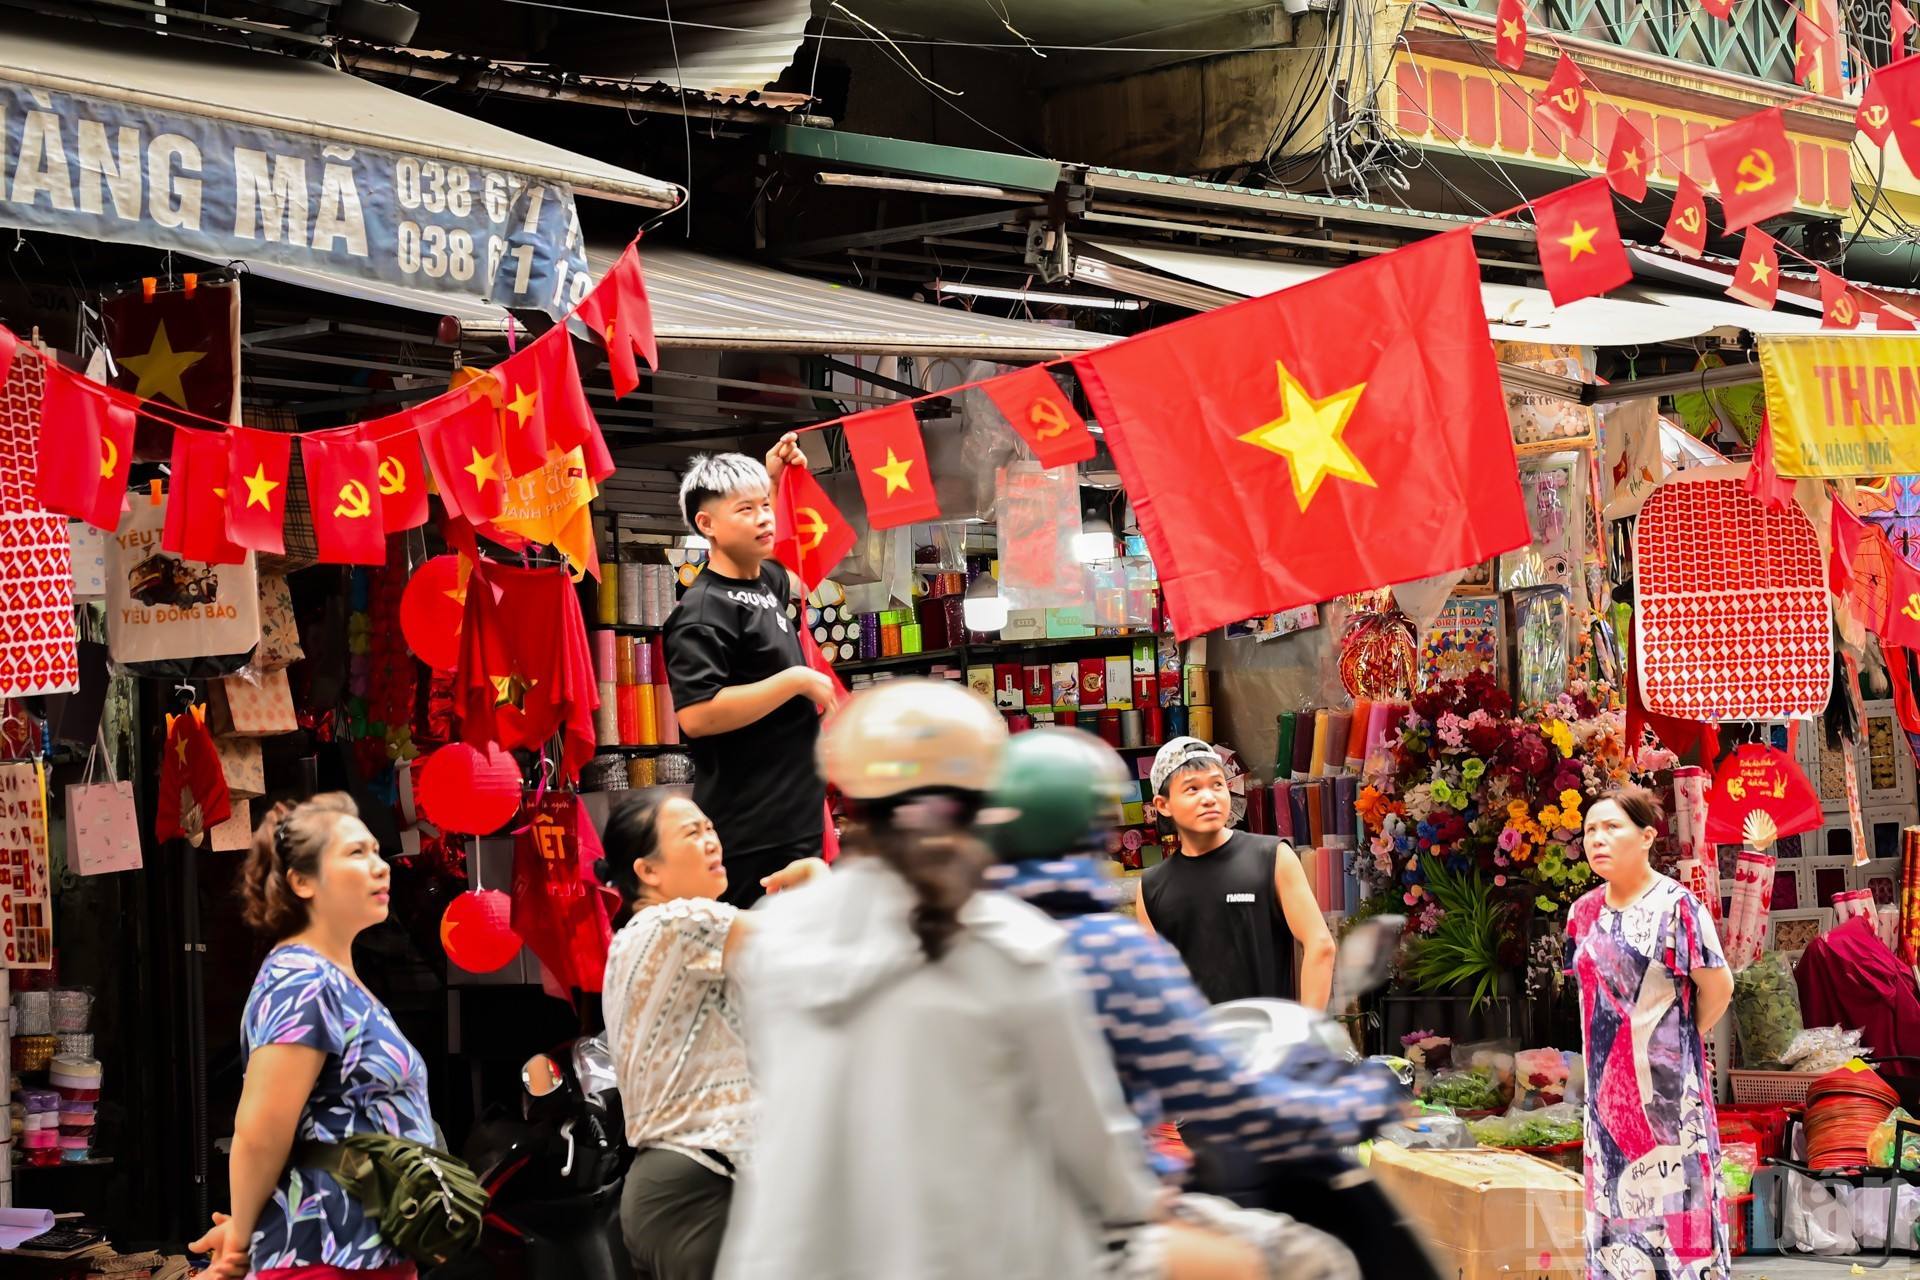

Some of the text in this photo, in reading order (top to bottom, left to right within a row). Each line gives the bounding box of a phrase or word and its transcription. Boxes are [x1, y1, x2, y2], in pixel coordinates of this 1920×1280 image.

[0, 88, 368, 257] ÀNG MÃ
[396, 156, 472, 218] 038
[397, 220, 475, 281] 038
[1825, 438, 1865, 466] HÀNG
[1867, 437, 1893, 465] MÃ
[116, 529, 152, 549] YÊU
[121, 607, 151, 625] YÊU
